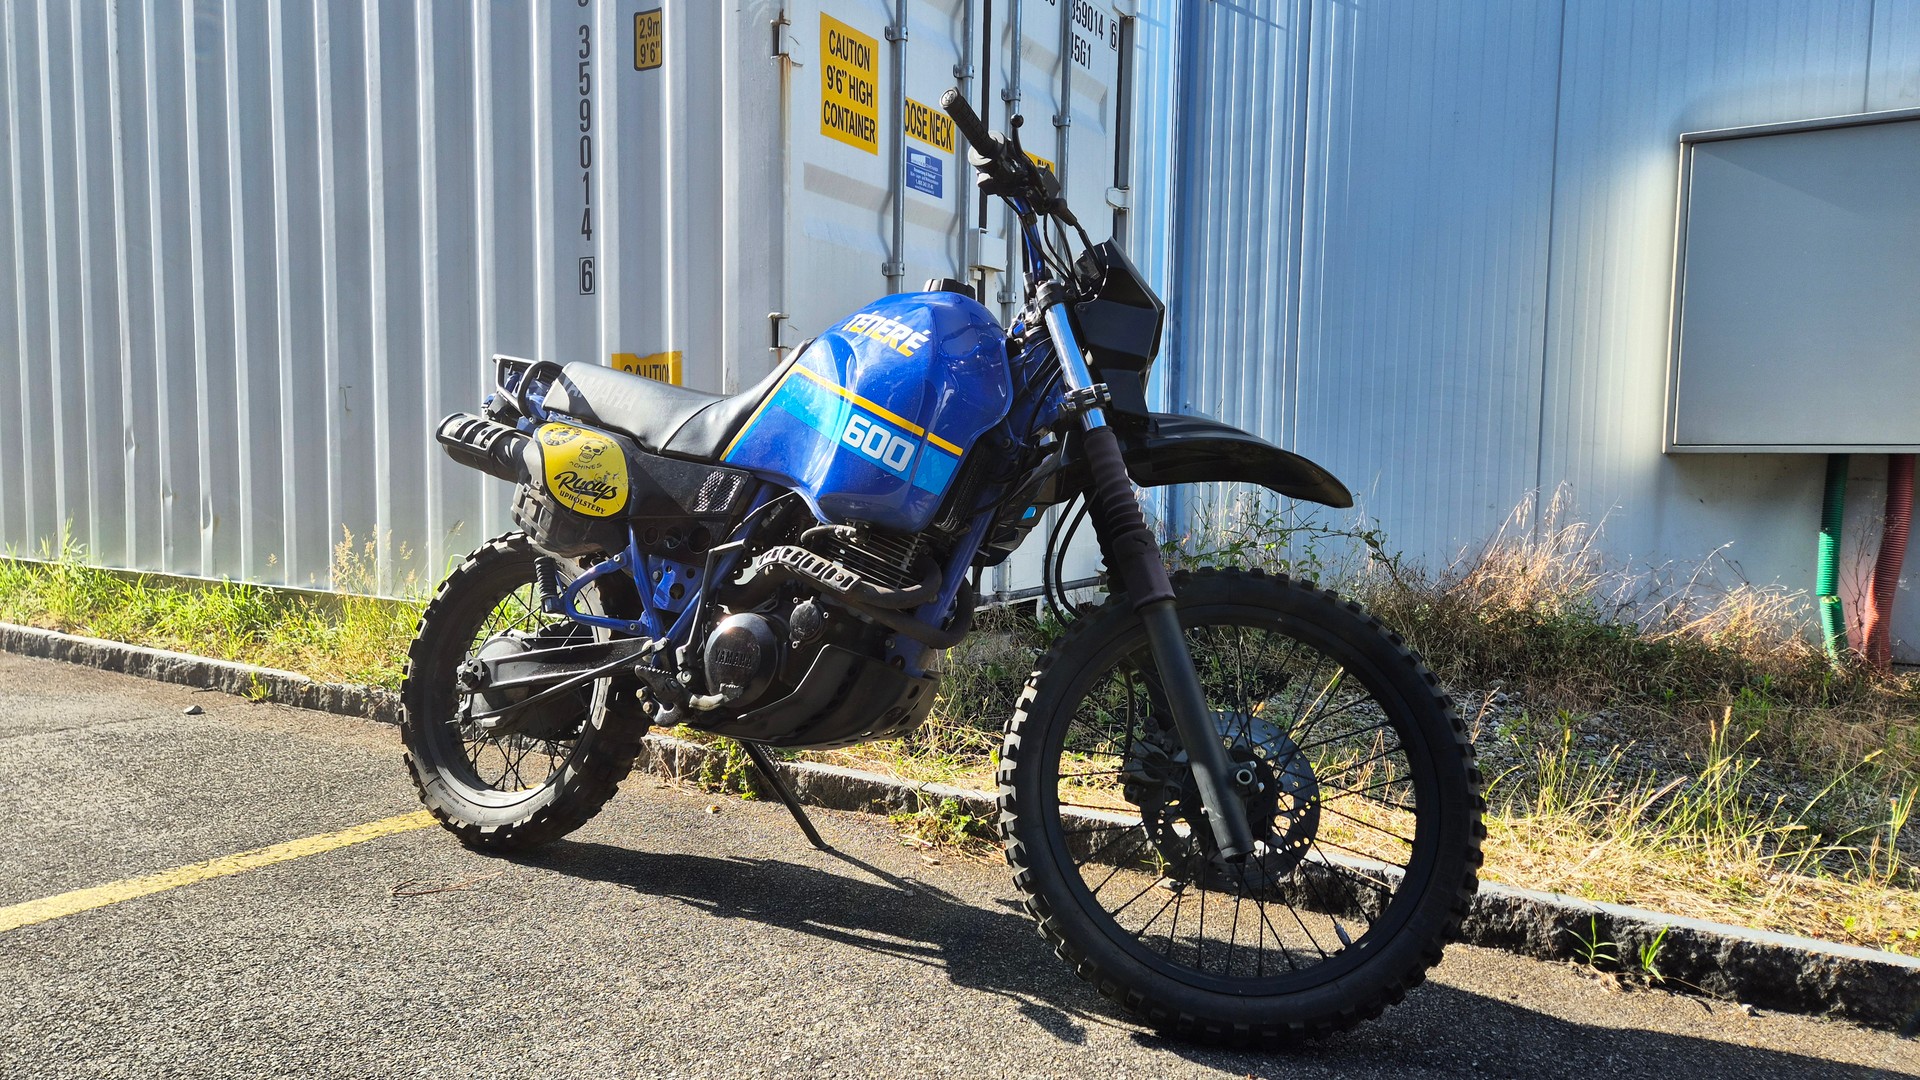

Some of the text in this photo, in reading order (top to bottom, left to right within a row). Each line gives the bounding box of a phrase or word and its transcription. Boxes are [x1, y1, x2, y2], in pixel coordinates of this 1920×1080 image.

[828, 29, 871, 72] CAUTION
[848, 74, 873, 108] HIGH
[823, 99, 876, 144] CONTAINER
[929, 110, 953, 151] NECK
[841, 413, 916, 473] 600
[559, 490, 607, 515] UPHOLSTERY
